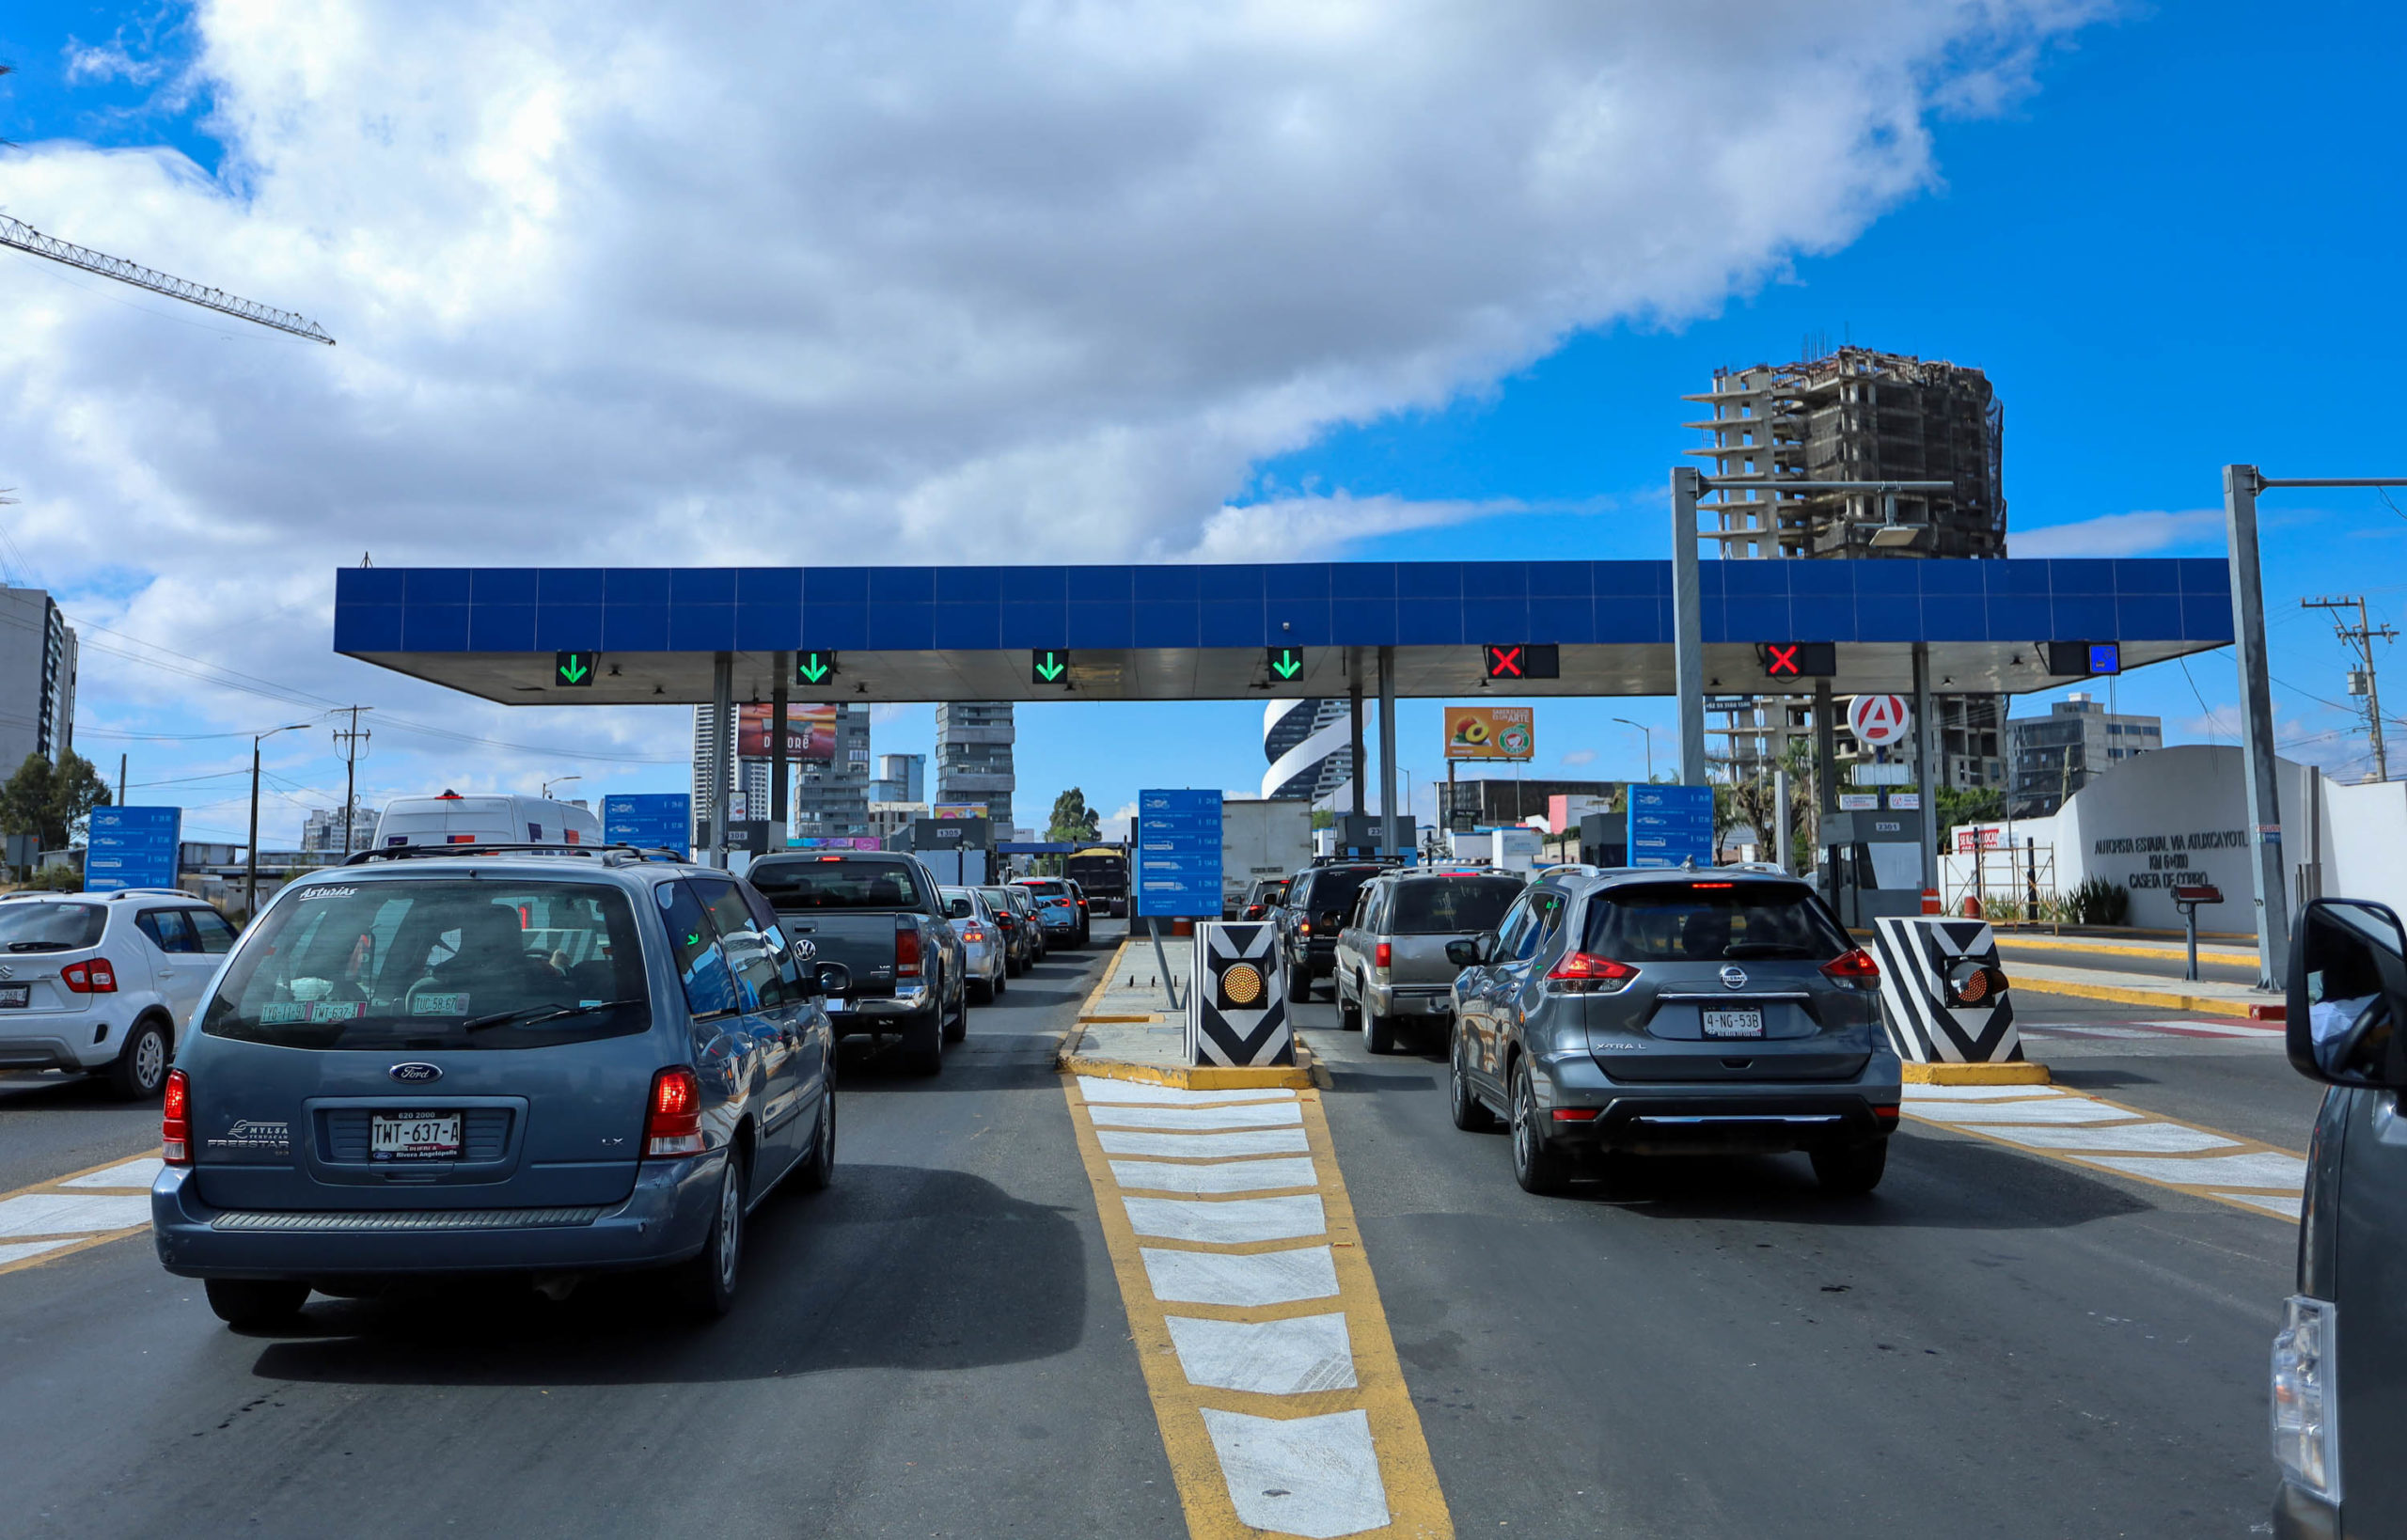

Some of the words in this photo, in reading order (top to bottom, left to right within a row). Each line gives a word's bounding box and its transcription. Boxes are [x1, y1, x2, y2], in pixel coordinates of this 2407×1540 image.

[2095, 839, 2134, 855] AUTOPISTA
[2170, 835, 2185, 851] VIA
[2148, 855, 2163, 870] KM
[2129, 872, 2162, 889] CASETA
[2163, 872, 2176, 888] DE
[299, 887, 358, 900] Asturias
[401, 1066, 431, 1078] Ford
[374, 1122, 459, 1144] TWT-637-A
[208, 1139, 290, 1148] FREESTAR
